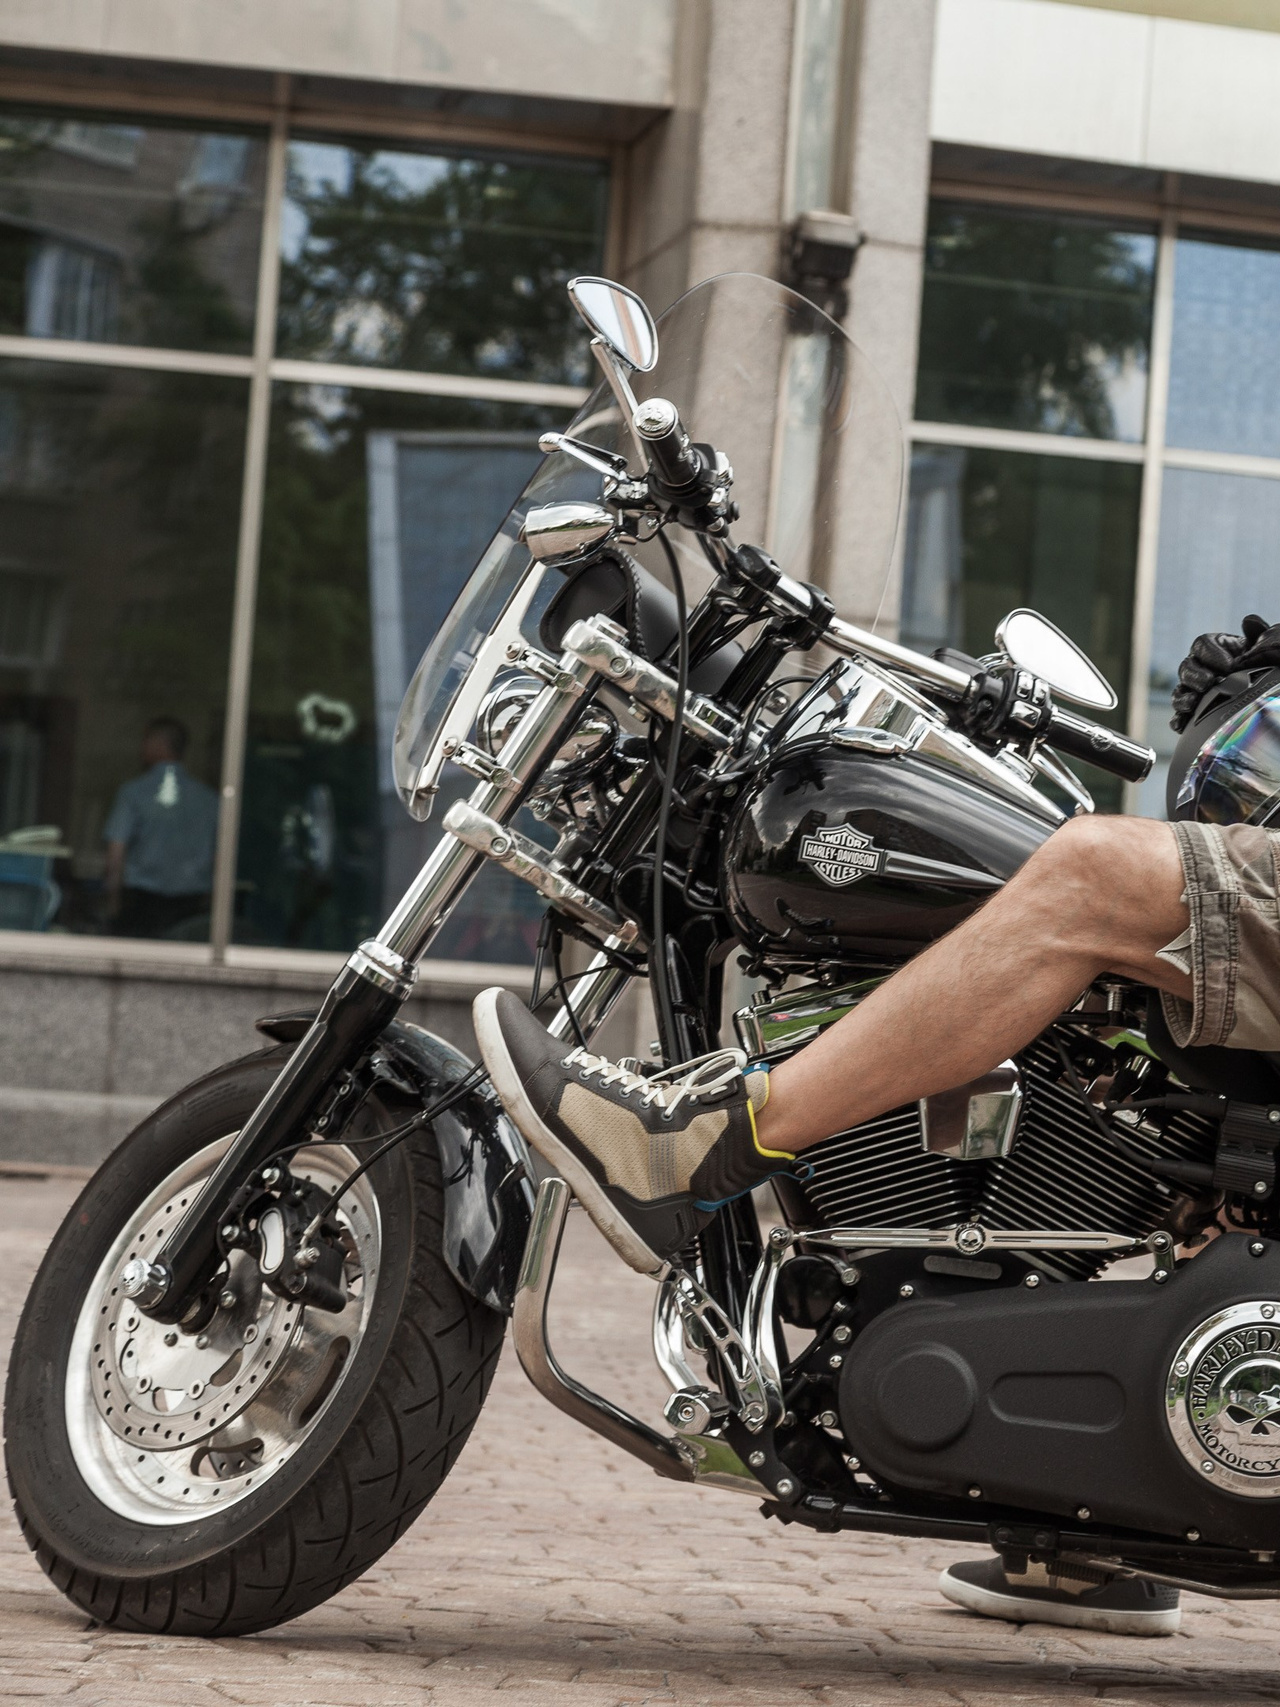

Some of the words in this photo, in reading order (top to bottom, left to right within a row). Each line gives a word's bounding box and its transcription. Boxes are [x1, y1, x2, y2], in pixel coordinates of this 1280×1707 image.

[825, 832, 863, 848] MOTOR
[806, 843, 876, 867] HARLEY-DAVIDSON
[819, 863, 856, 881] CYCLES
